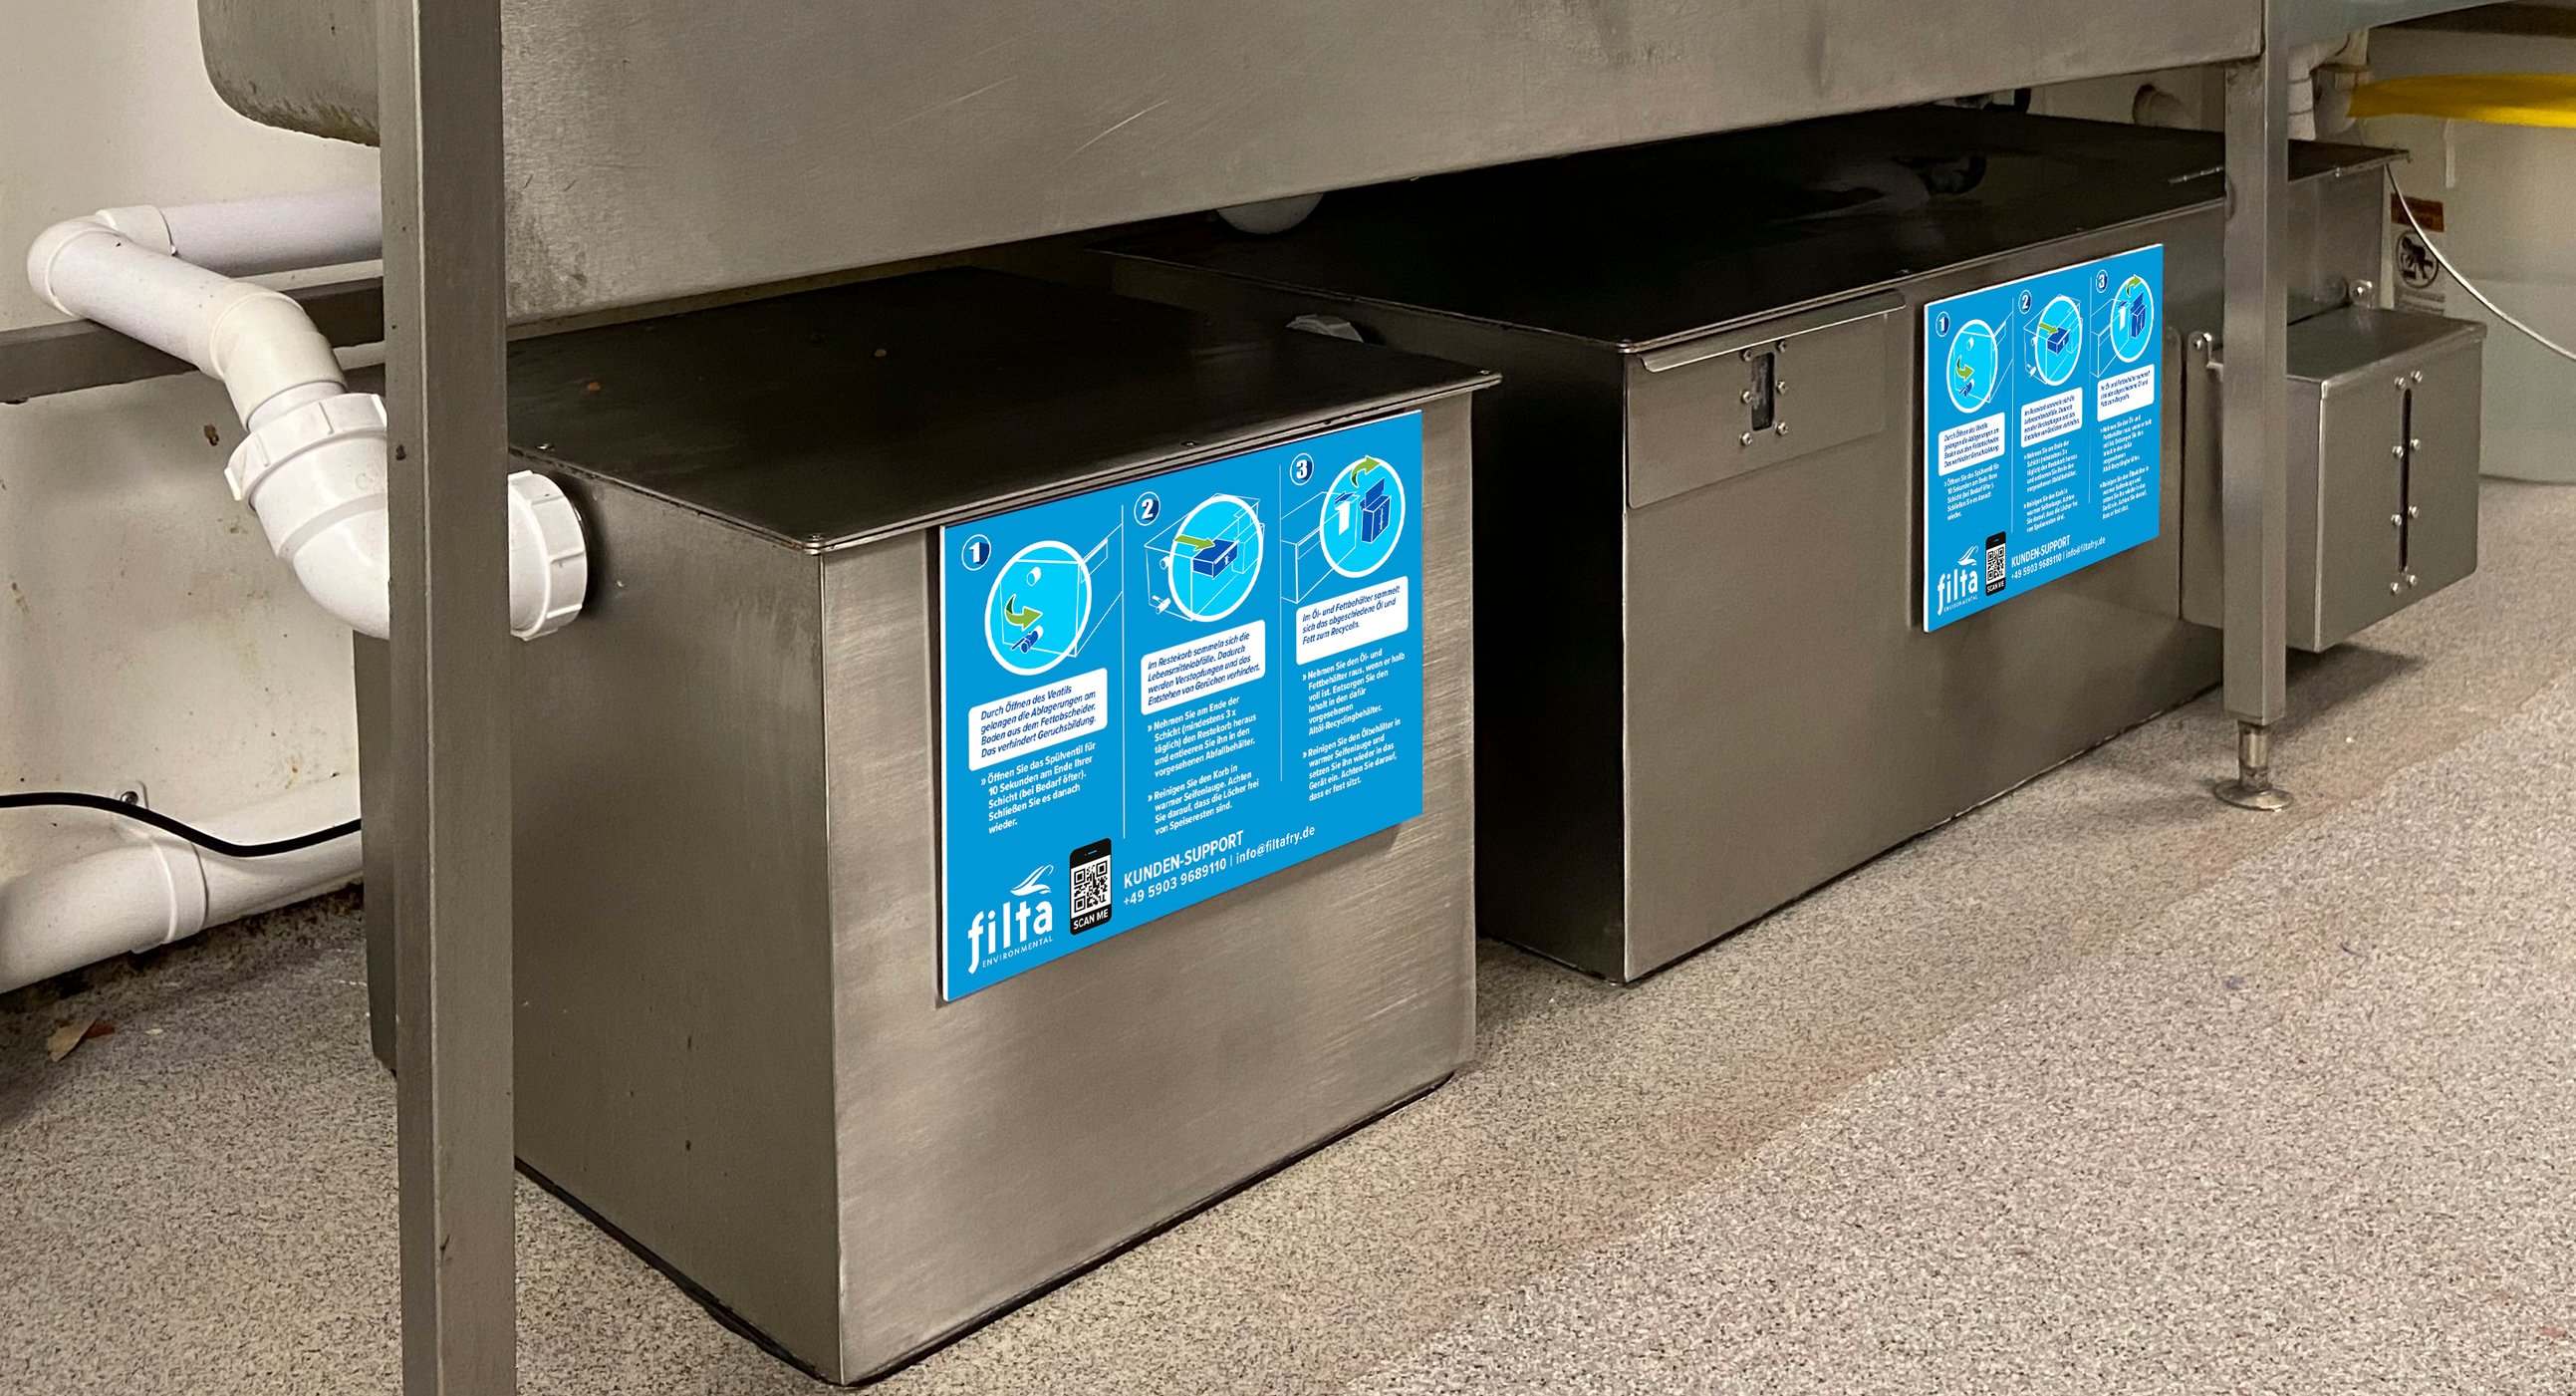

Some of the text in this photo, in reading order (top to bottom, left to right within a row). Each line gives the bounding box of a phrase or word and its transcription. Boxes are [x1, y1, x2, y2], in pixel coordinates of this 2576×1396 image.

[2099, 274, 2105, 289] 3
[2022, 294, 2029, 310] 2
[1939, 317, 1945, 332] 1
[1296, 459, 1308, 479] 3
[1142, 498, 1154, 520] 2
[969, 541, 980, 563] 1
[2011, 534, 2071, 568] KUNDEN-SUPPORT
[2011, 569, 2022, 579] +49
[2023, 563, 2038, 576] 5903
[1937, 568, 1978, 616] filta
[1148, 632, 1250, 671] Im Restekorb sammeln sich die
[1217, 645, 1245, 661] Dadurch
[1308, 648, 1383, 680] Nehmen Sie den Öl- und
[1148, 656, 1251, 694] werden Verstopfungen und das
[1148, 664, 1260, 706] Entstehen von Gerüchen verhindert.
[1308, 673, 1348, 691] Fettbehälter
[1366, 661, 1384, 672] wenn
[1392, 653, 1406, 663] halb
[1308, 692, 1321, 701] voll
[1333, 678, 1365, 695] Entsorgen
[1366, 674, 1376, 683] Sie
[1376, 670, 1389, 680] den
[981, 686, 1072, 720] Durch Öffnen des Ventils
[981, 692, 1096, 735] gelangen die Ablagerungen am
[1154, 697, 1239, 730] Nehmen Sie am Ende der
[1308, 688, 1367, 713] Inhalt in den dafür
[981, 703, 1096, 745] Boden aus dem Fettabscheider.
[981, 715, 1096, 758] Das verhindert Geruchsbildung.
[1155, 726, 1181, 742] Schicht
[1181, 713, 1225, 734] (mindestens
[1226, 709, 1231, 718] 3
[1155, 714, 1256, 754] täglich) den Restekorb heraus
[1308, 717, 1401, 757] Reinigen Sie den Ölbehälter in
[987, 741, 1096, 784] Öffnen Sie das Spülventil für
[1155, 727, 1250, 766] und entleeren Sie ihn in den
[1155, 737, 1255, 777] vorgesehenen Abfallbehälter.
[1309, 733, 1385, 768] warmer Seifenlauge und
[1309, 766, 1330, 779] setzen
[1331, 761, 1342, 771] Sie
[1342, 758, 1353, 767] ihn
[1353, 749, 1376, 762] wieder
[1383, 743, 1395, 752] das
[988, 756, 1093, 796] 10 Sekunden am Ende Ihrer
[988, 769, 1087, 809] Schicht (bei Bedarf öfter).
[1154, 764, 1238, 800] Reinigen Sie den Korb in
[1155, 771, 1252, 812] warmer Seifenlauge. Achten
[1309, 777, 1327, 790] Gerät
[1341, 765, 1364, 778] Achten
[1364, 761, 1374, 770] Sie
[988, 783, 1081, 822] Schließen Sie es danach
[1155, 779, 1259, 824] Sie darauf, dass die Löcher frei
[1155, 800, 1232, 835] von Speiseresten sind.
[988, 819, 1018, 834] wieder.
[1124, 830, 1244, 889] KUNDEN-SUPPORT
[1124, 826, 1315, 905] +49 5903 9689110 info@filtafry.de
[1073, 908, 1109, 930] SCAN ME
[967, 901, 1053, 975] filta
[982, 938, 1052, 968] ENVIRONMENTAL
